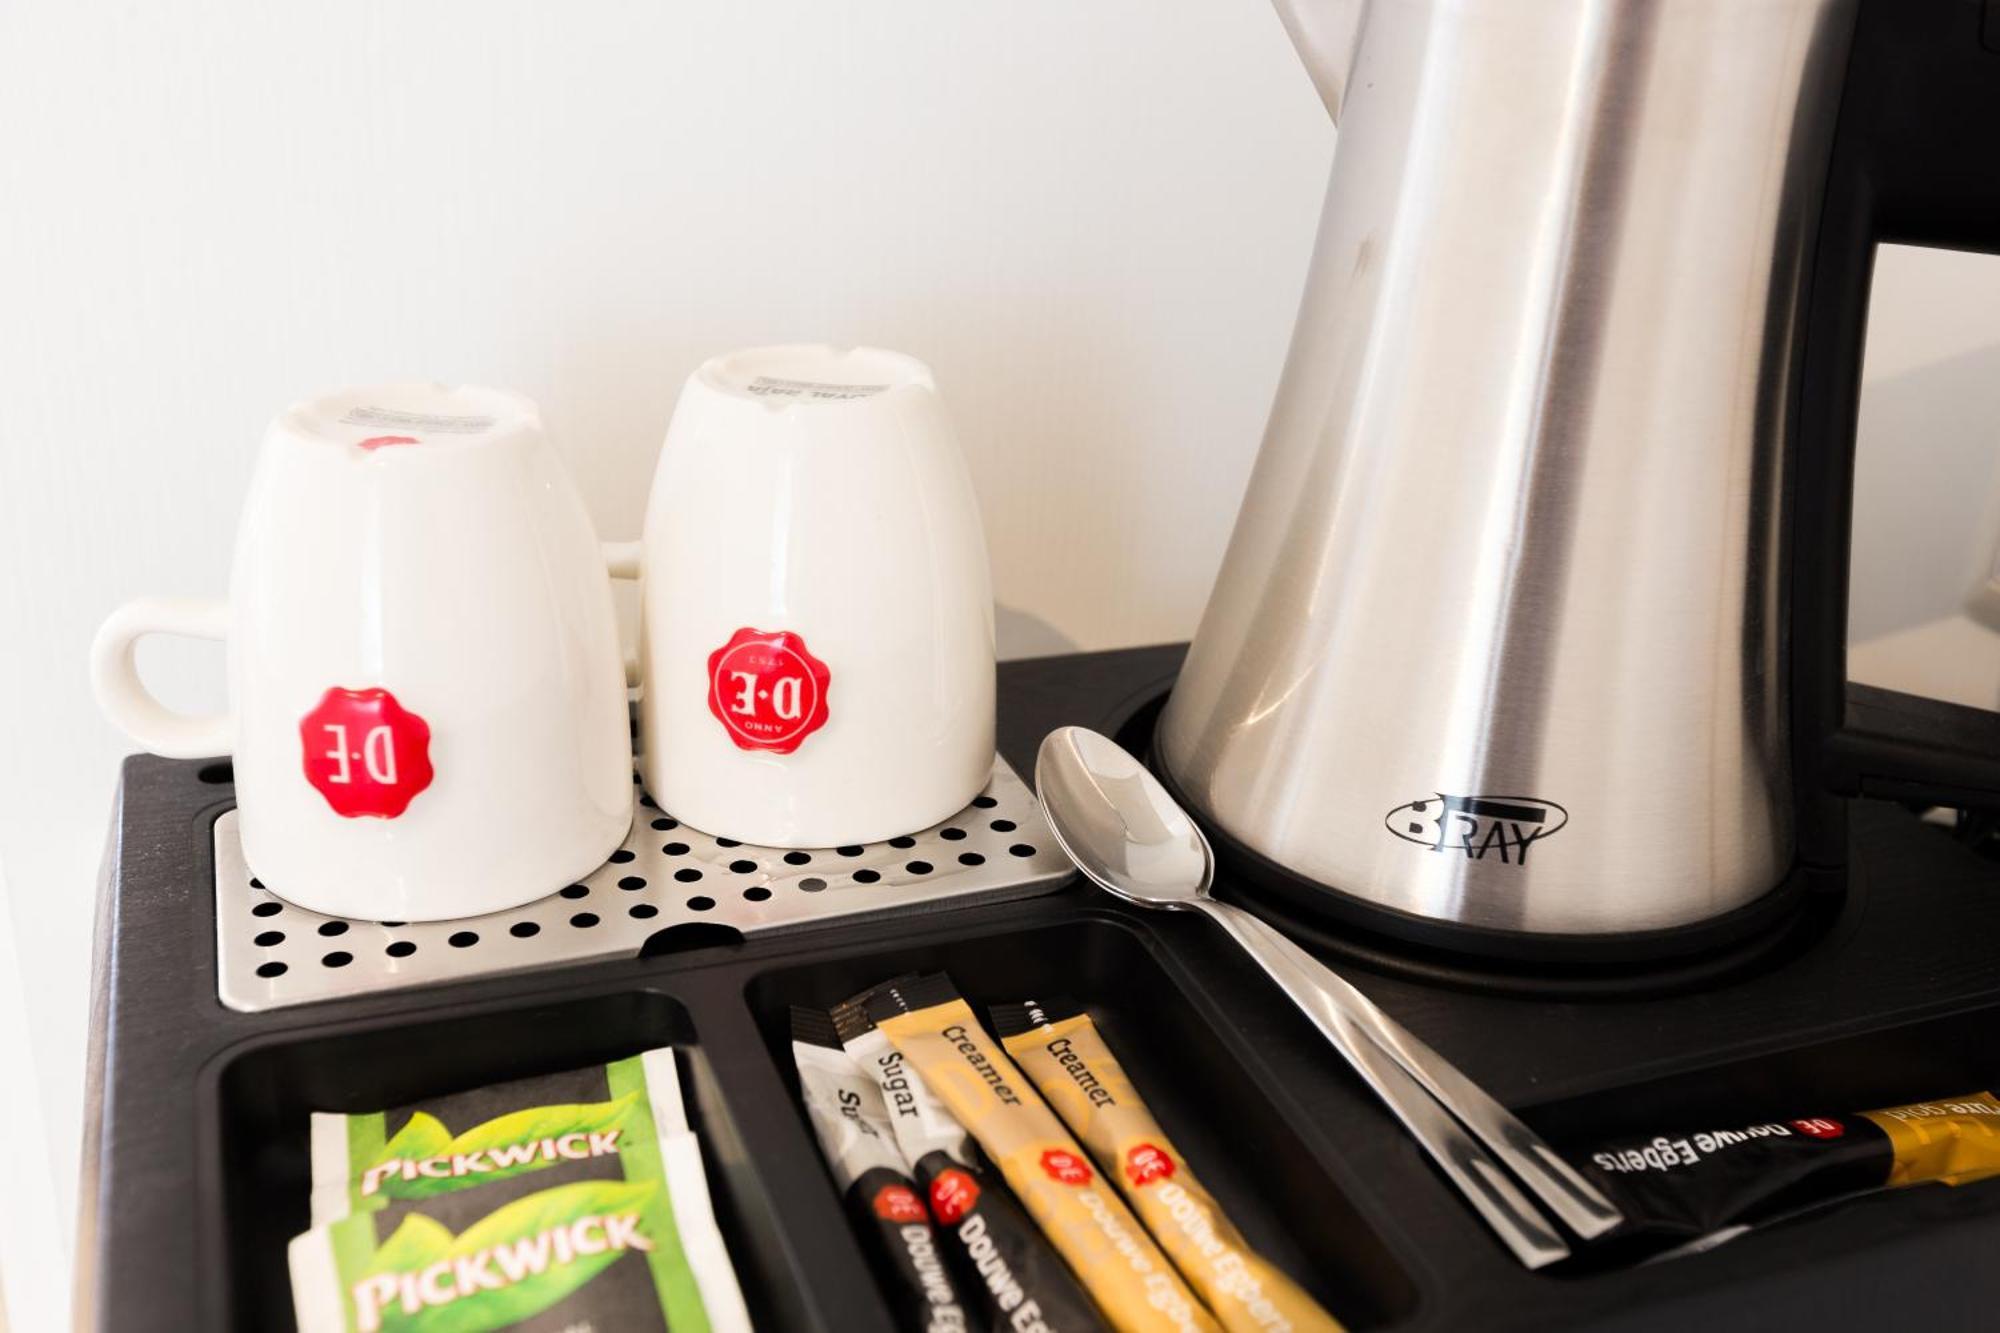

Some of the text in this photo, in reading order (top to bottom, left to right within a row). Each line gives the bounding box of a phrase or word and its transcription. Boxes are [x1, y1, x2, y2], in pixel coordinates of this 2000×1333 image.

[744, 721, 783, 733] ANNO
[1407, 792, 1546, 866] BRAY
[879, 1051, 919, 1118] Sugar
[942, 1025, 1021, 1106] Creamer
[1047, 1038, 1117, 1109] Creamer
[361, 1129, 624, 1197] PICKWICK
[1592, 1136, 1701, 1173] Egberts
[351, 1213, 656, 1333] PICKWICK
[901, 1224, 954, 1304] Douwe
[959, 1213, 1024, 1311] Douwe
